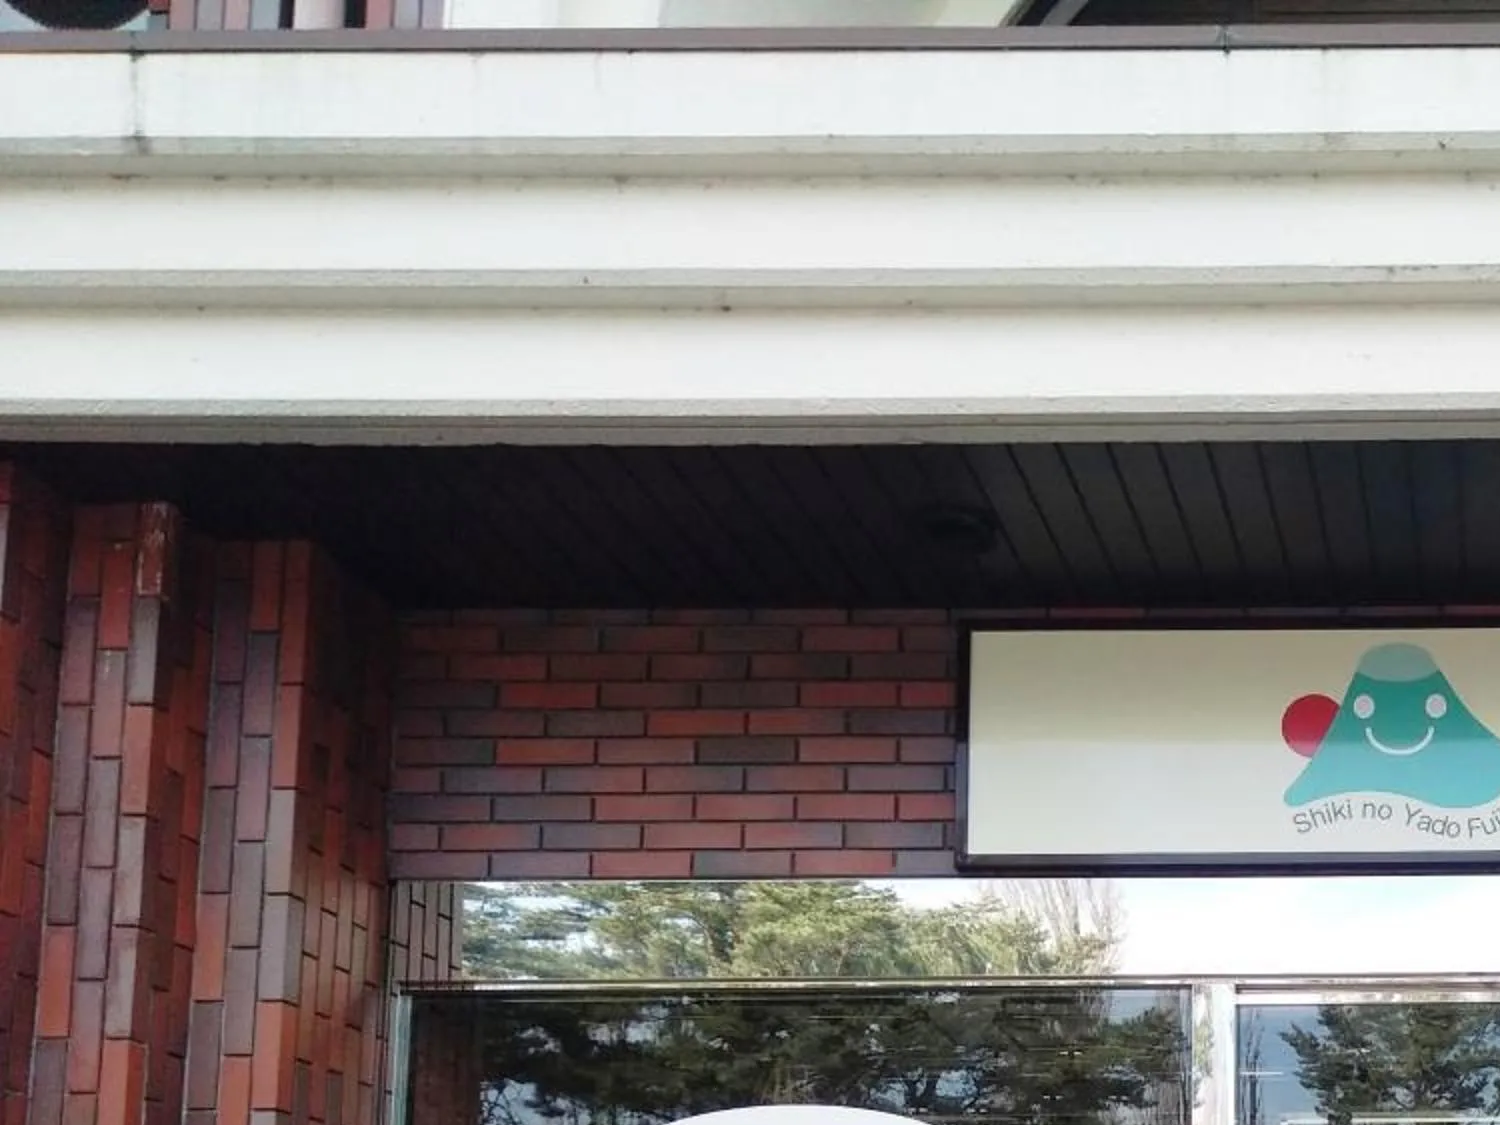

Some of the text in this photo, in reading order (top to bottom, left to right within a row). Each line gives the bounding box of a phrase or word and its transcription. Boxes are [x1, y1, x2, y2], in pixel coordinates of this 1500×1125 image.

[1291, 798, 1354, 835] Shiki
[1362, 802, 1394, 822] no
[1404, 803, 1461, 838] Yado
